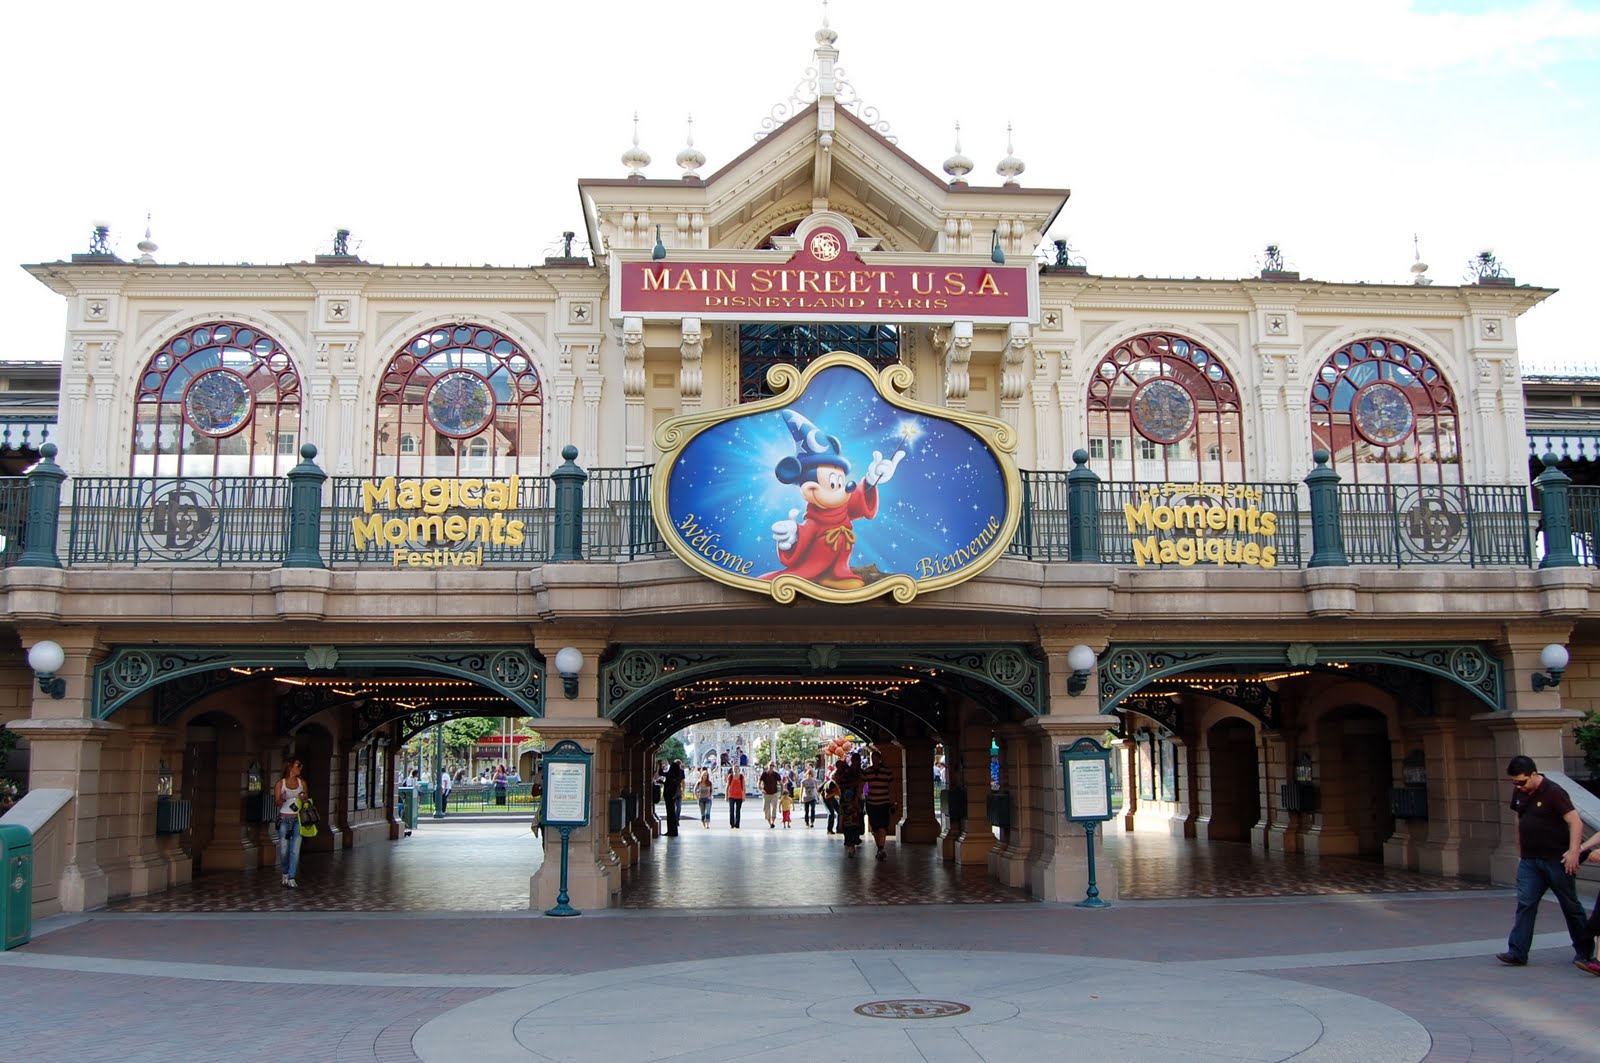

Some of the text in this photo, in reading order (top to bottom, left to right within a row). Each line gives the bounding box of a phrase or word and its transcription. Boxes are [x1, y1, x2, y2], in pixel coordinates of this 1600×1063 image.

[640, 268, 1009, 297] MAIN STREET, U.S.A.
[704, 296, 948, 309] DISNEYLAND PARIS
[362, 474, 519, 514] Magical
[1139, 480, 1264, 502] Le Festival des
[351, 512, 526, 551] Moments
[1124, 500, 1278, 537] Moments
[393, 547, 484, 567] Festival
[680, 513, 755, 575] Welcome
[915, 515, 1000, 579] Bienvenue
[1132, 528, 1278, 569] Magiques
